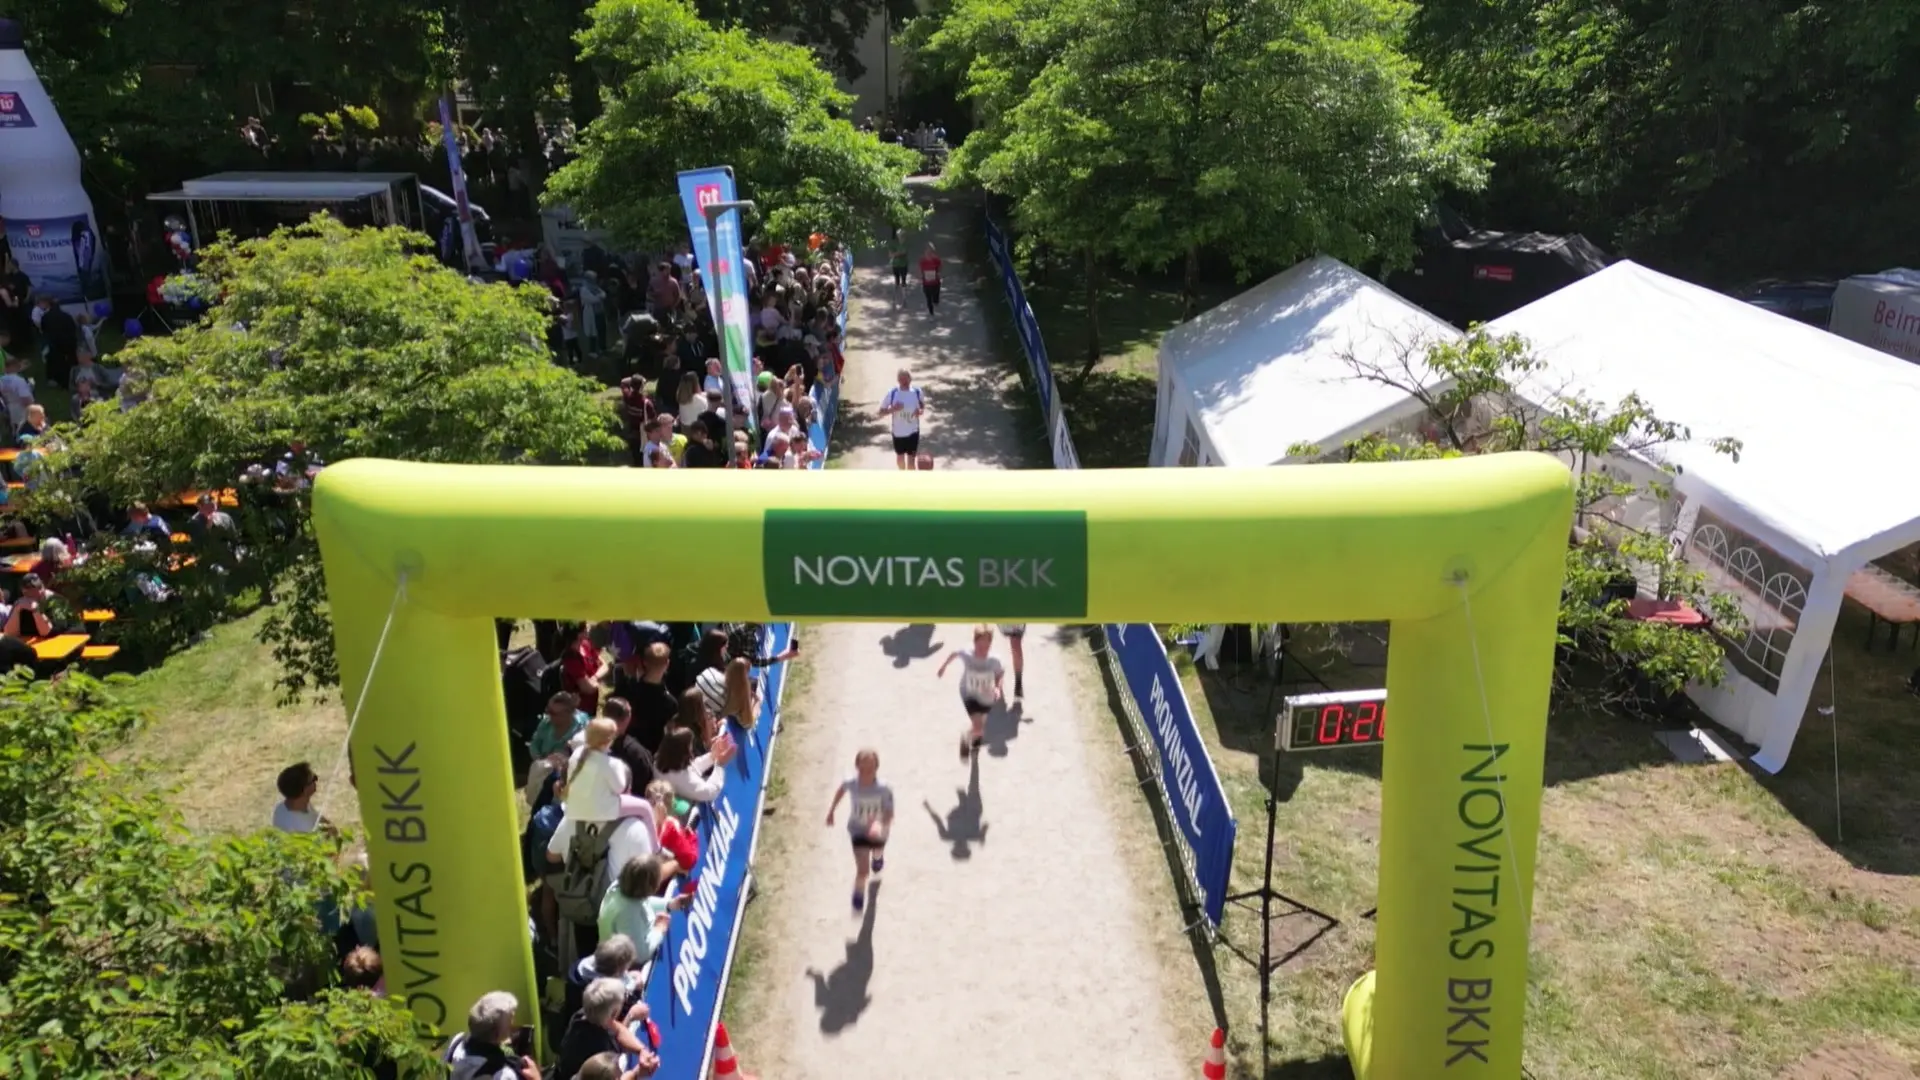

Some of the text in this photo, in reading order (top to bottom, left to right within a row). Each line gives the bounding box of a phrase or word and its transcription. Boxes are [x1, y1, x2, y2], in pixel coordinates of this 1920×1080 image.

[794, 555, 1057, 588] NOVITAS BKK
[373, 740, 428, 844] BKK
[1150, 672, 1203, 838] PROVINZIAL
[673, 796, 741, 1017] PROVINZIAL
[1444, 742, 1511, 1069] NOVITAS BKK
